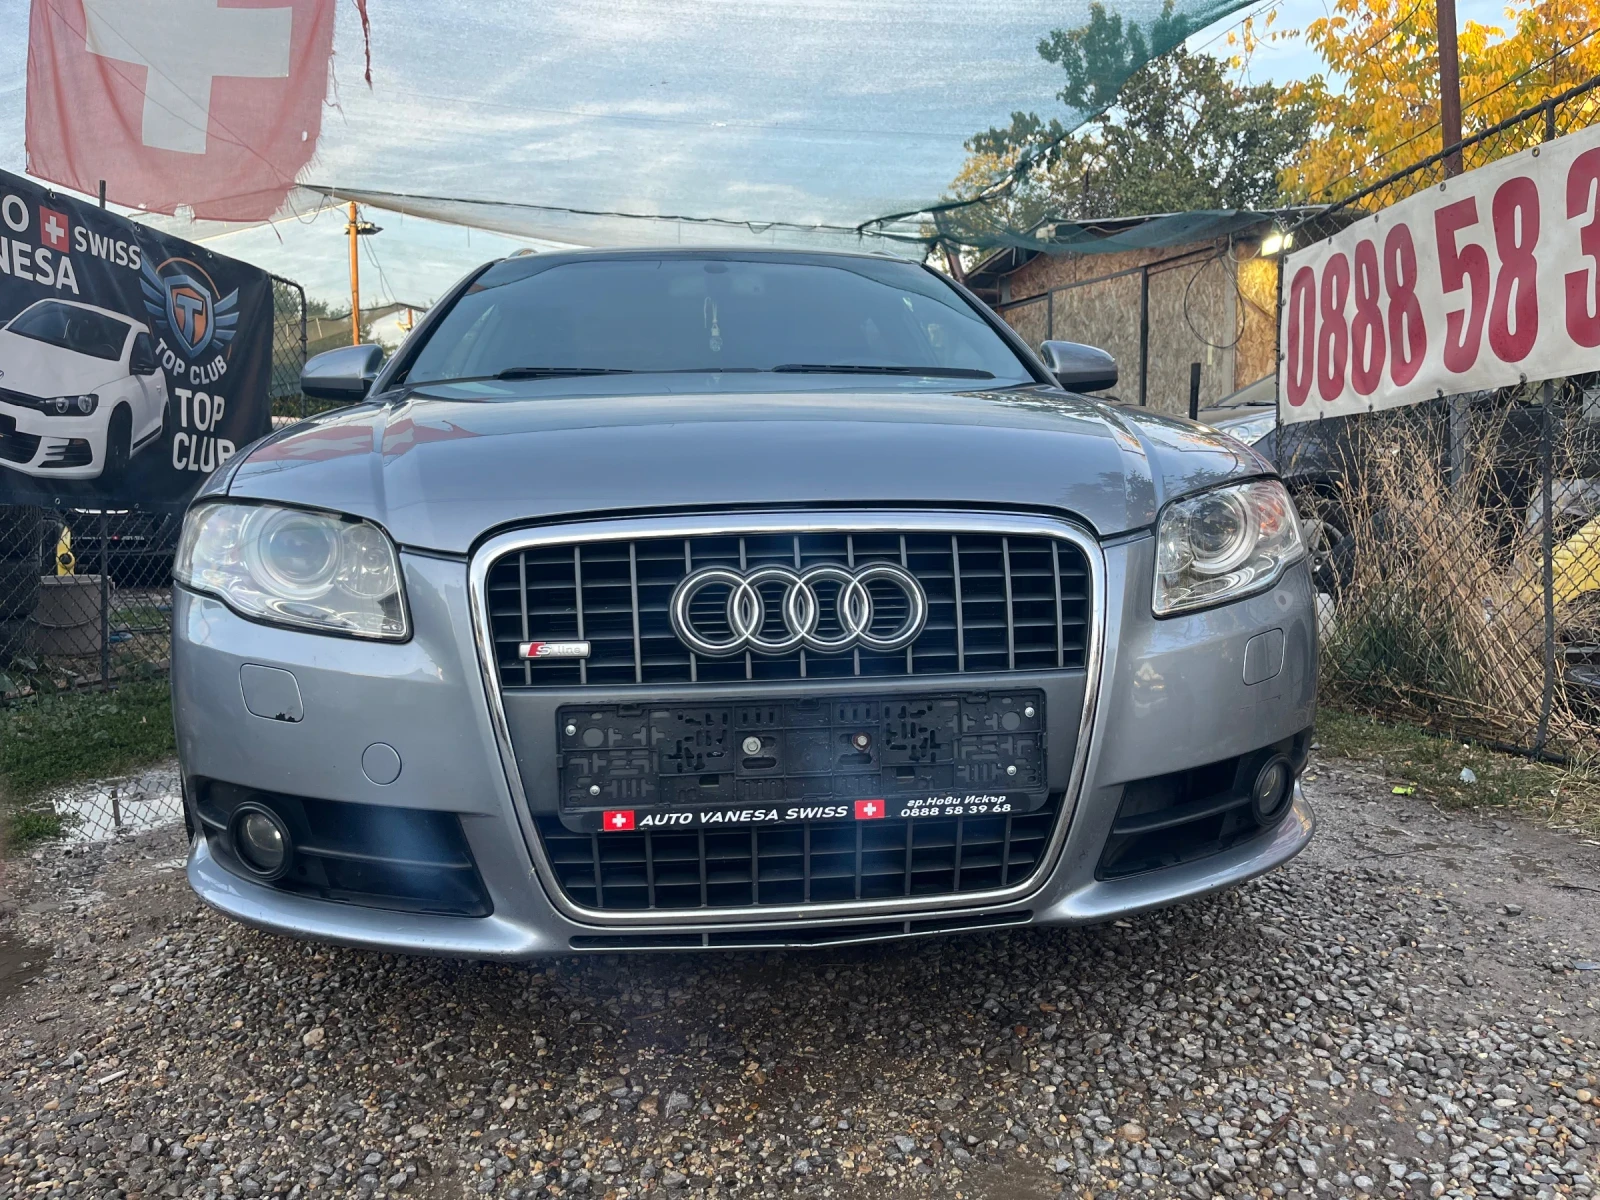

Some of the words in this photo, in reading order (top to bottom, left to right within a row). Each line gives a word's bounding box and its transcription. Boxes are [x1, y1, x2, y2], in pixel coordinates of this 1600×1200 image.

[74, 225, 141, 270] SWISS
[1286, 222, 1427, 407] 0888
[1434, 176, 1541, 374] 58
[155, 337, 186, 376] TOP
[189, 354, 228, 385] CLUB
[175, 387, 225, 432] TOP
[557, 645, 581, 654] line
[639, 812, 693, 827] AUTO
[700, 808, 778, 824] VANESA
[785, 805, 848, 820] SWISS
[900, 807, 939, 817] 0888
[944, 806, 964, 815] 58
[968, 805, 988, 814] 39
[992, 803, 1012, 812] 68
[964, 795, 1007, 804] Искър
